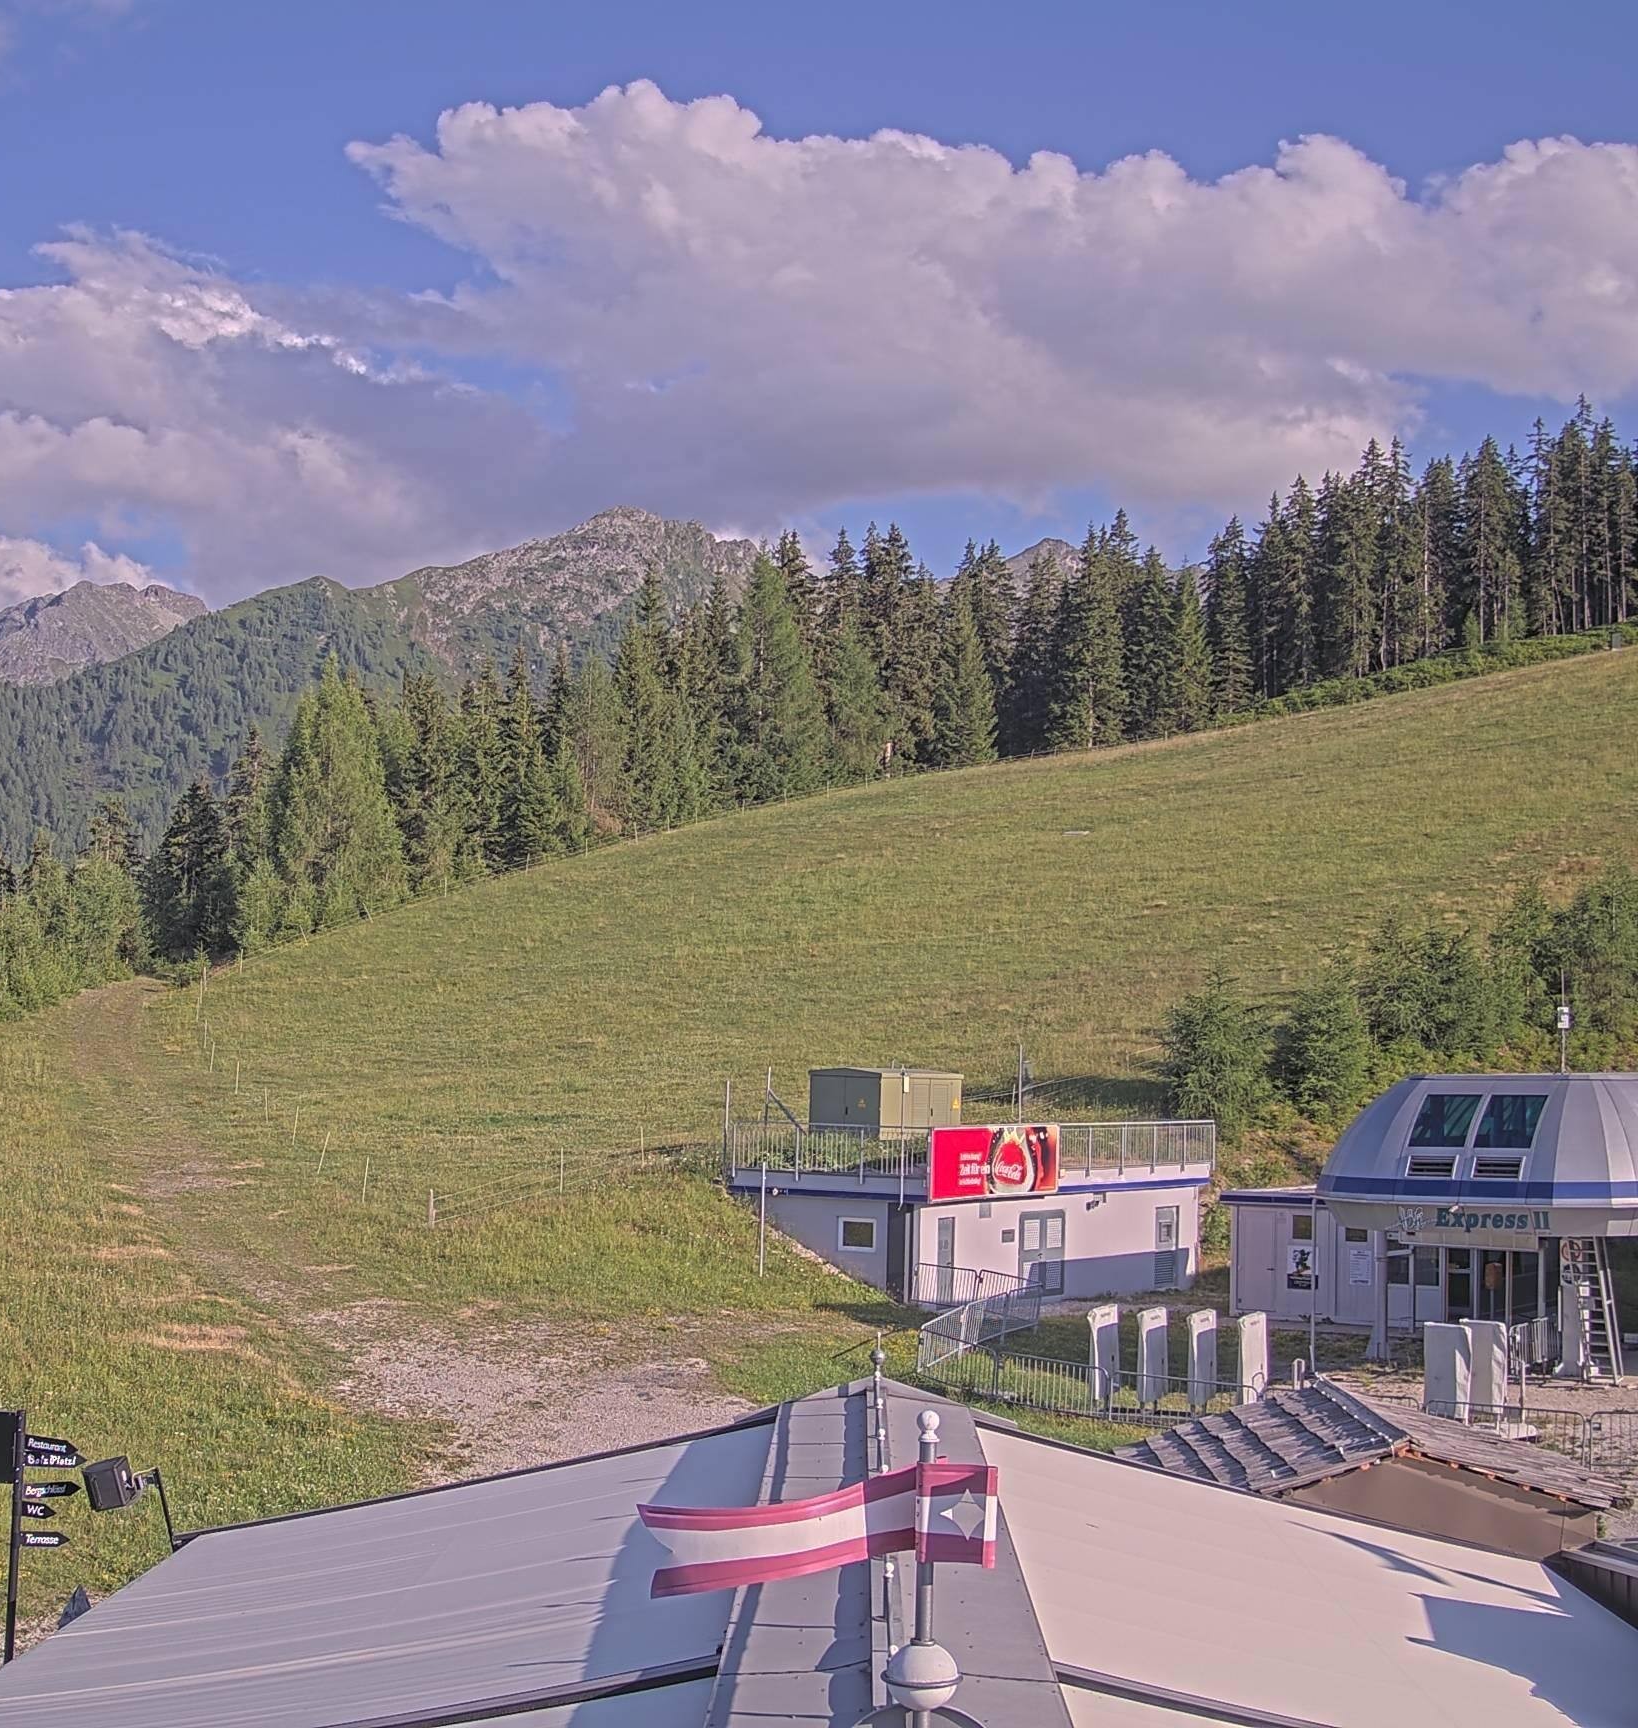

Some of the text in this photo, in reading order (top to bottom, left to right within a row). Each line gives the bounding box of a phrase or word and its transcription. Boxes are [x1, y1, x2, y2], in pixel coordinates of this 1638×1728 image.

[1436, 1207, 1529, 1233] Express
[28, 1437, 67, 1452] Restaurant
[27, 1504, 45, 1516] WC
[26, 1533, 59, 1545] Terrasse
